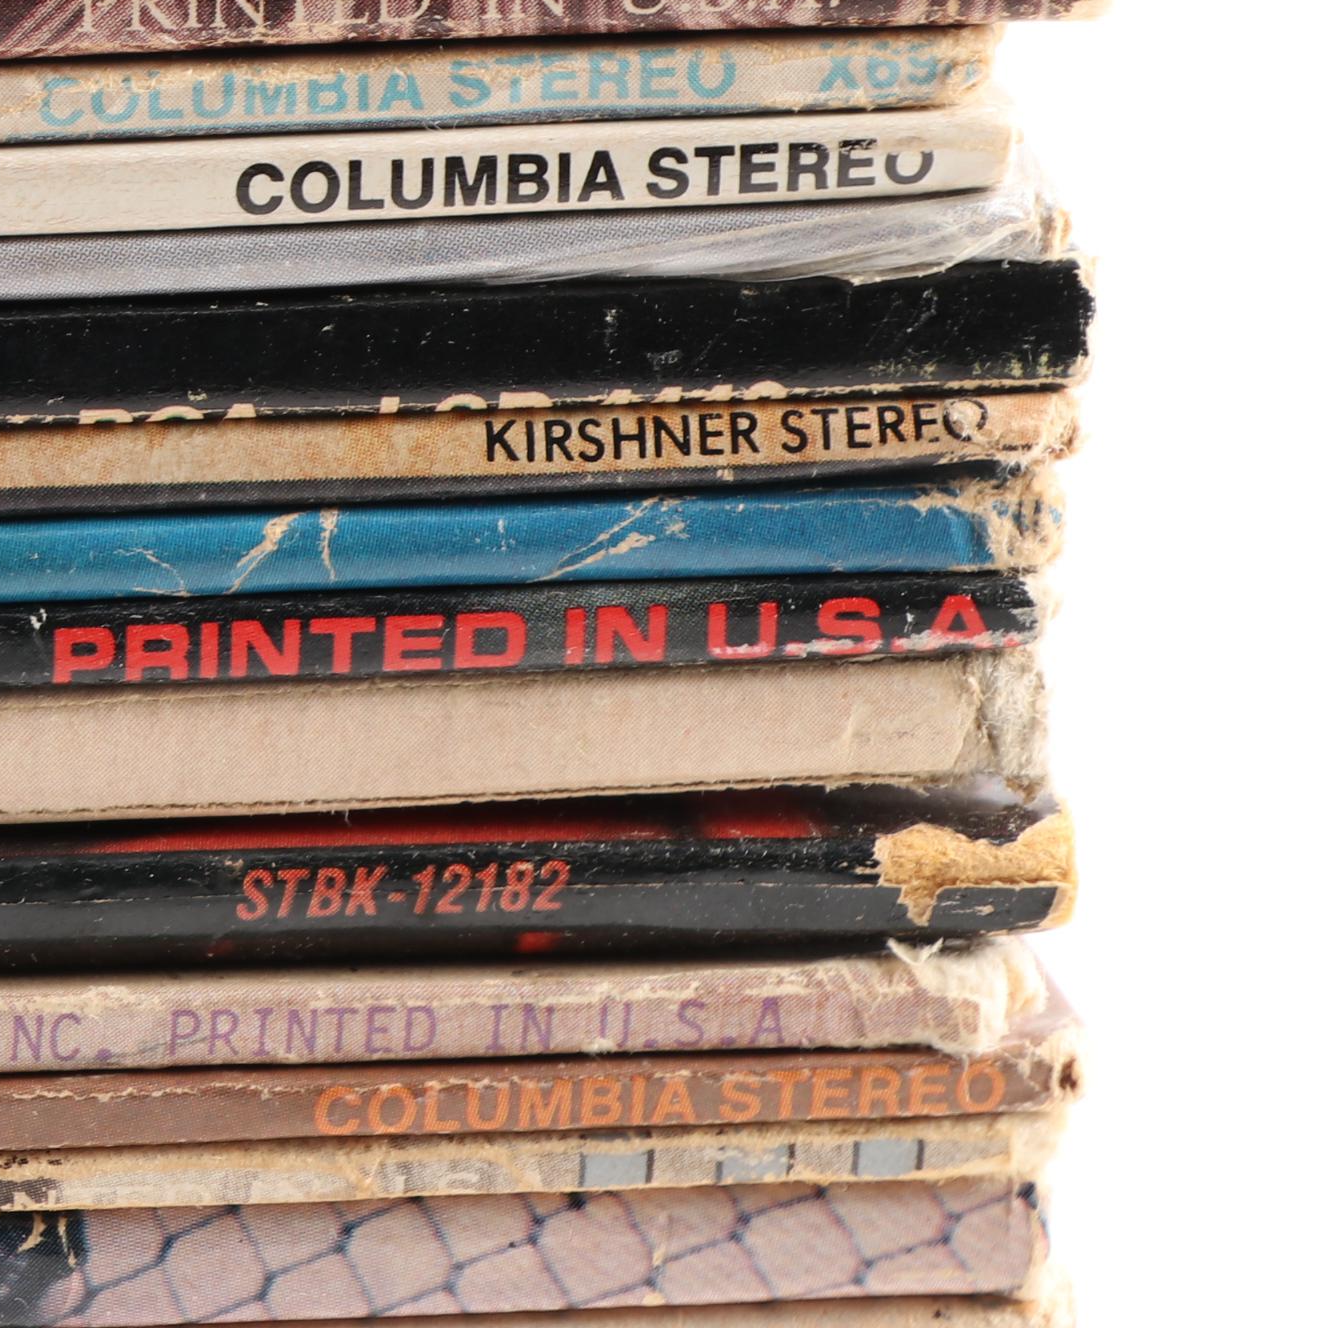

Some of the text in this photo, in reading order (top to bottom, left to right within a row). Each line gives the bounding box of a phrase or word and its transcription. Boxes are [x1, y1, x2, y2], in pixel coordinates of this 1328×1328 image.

[38, 55, 425, 129] COLUMBIA
[450, 40, 738, 112] STEREO
[234, 137, 935, 218] COLUMBIA STEREO
[485, 397, 990, 463] KIRSHNER STEREO
[50, 608, 526, 685] PRINTED
[564, 603, 667, 666] IN
[235, 858, 572, 922] STBK-12182
[168, 1003, 439, 1062] PRINTED
[484, 1002, 555, 1052] IN
[312, 1064, 1007, 1137] COLUMBIA STEREO
